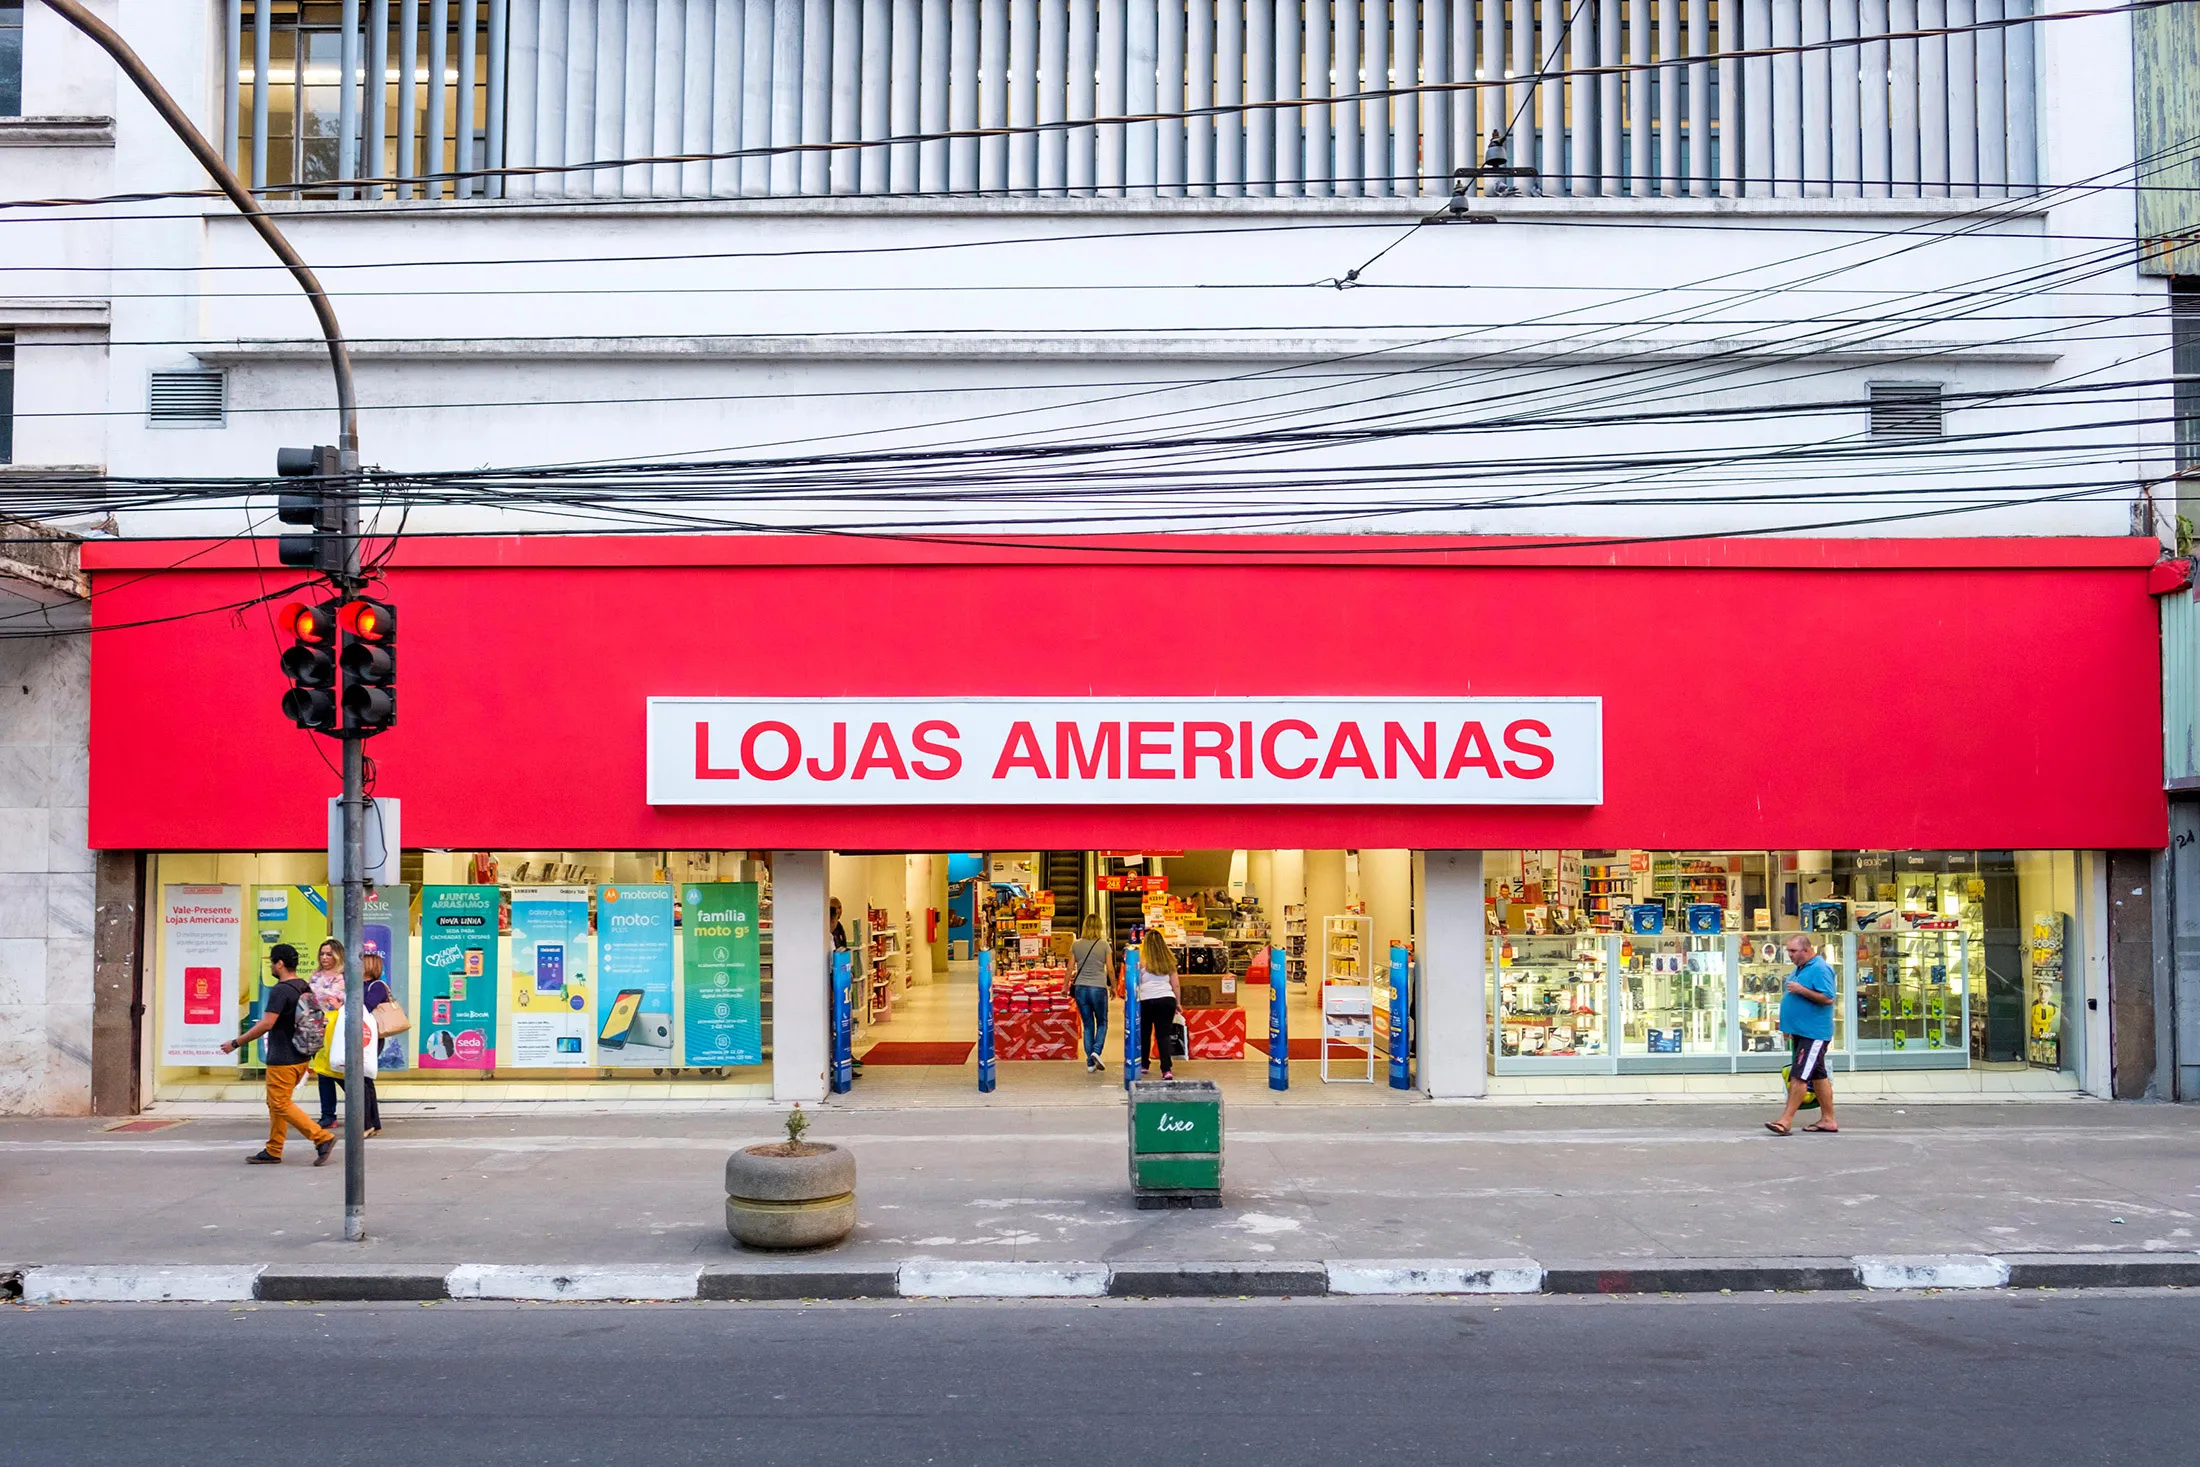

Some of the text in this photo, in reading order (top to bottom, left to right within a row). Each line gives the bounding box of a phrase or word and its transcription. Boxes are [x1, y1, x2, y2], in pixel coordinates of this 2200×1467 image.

[694, 720, 1555, 781] LOJAS AMERICANAS
[304, 887, 314, 898] 2
[440, 892, 480, 901] #JUNTAS
[620, 890, 668, 900] motorola
[172, 905, 232, 914] Vale-Presente
[165, 915, 239, 925] Lojas Americanas
[611, 913, 650, 926] moto
[697, 909, 746, 922] família
[694, 926, 731, 937] moto
[457, 1037, 481, 1047] seda
[1157, 1113, 1195, 1132] lixo
